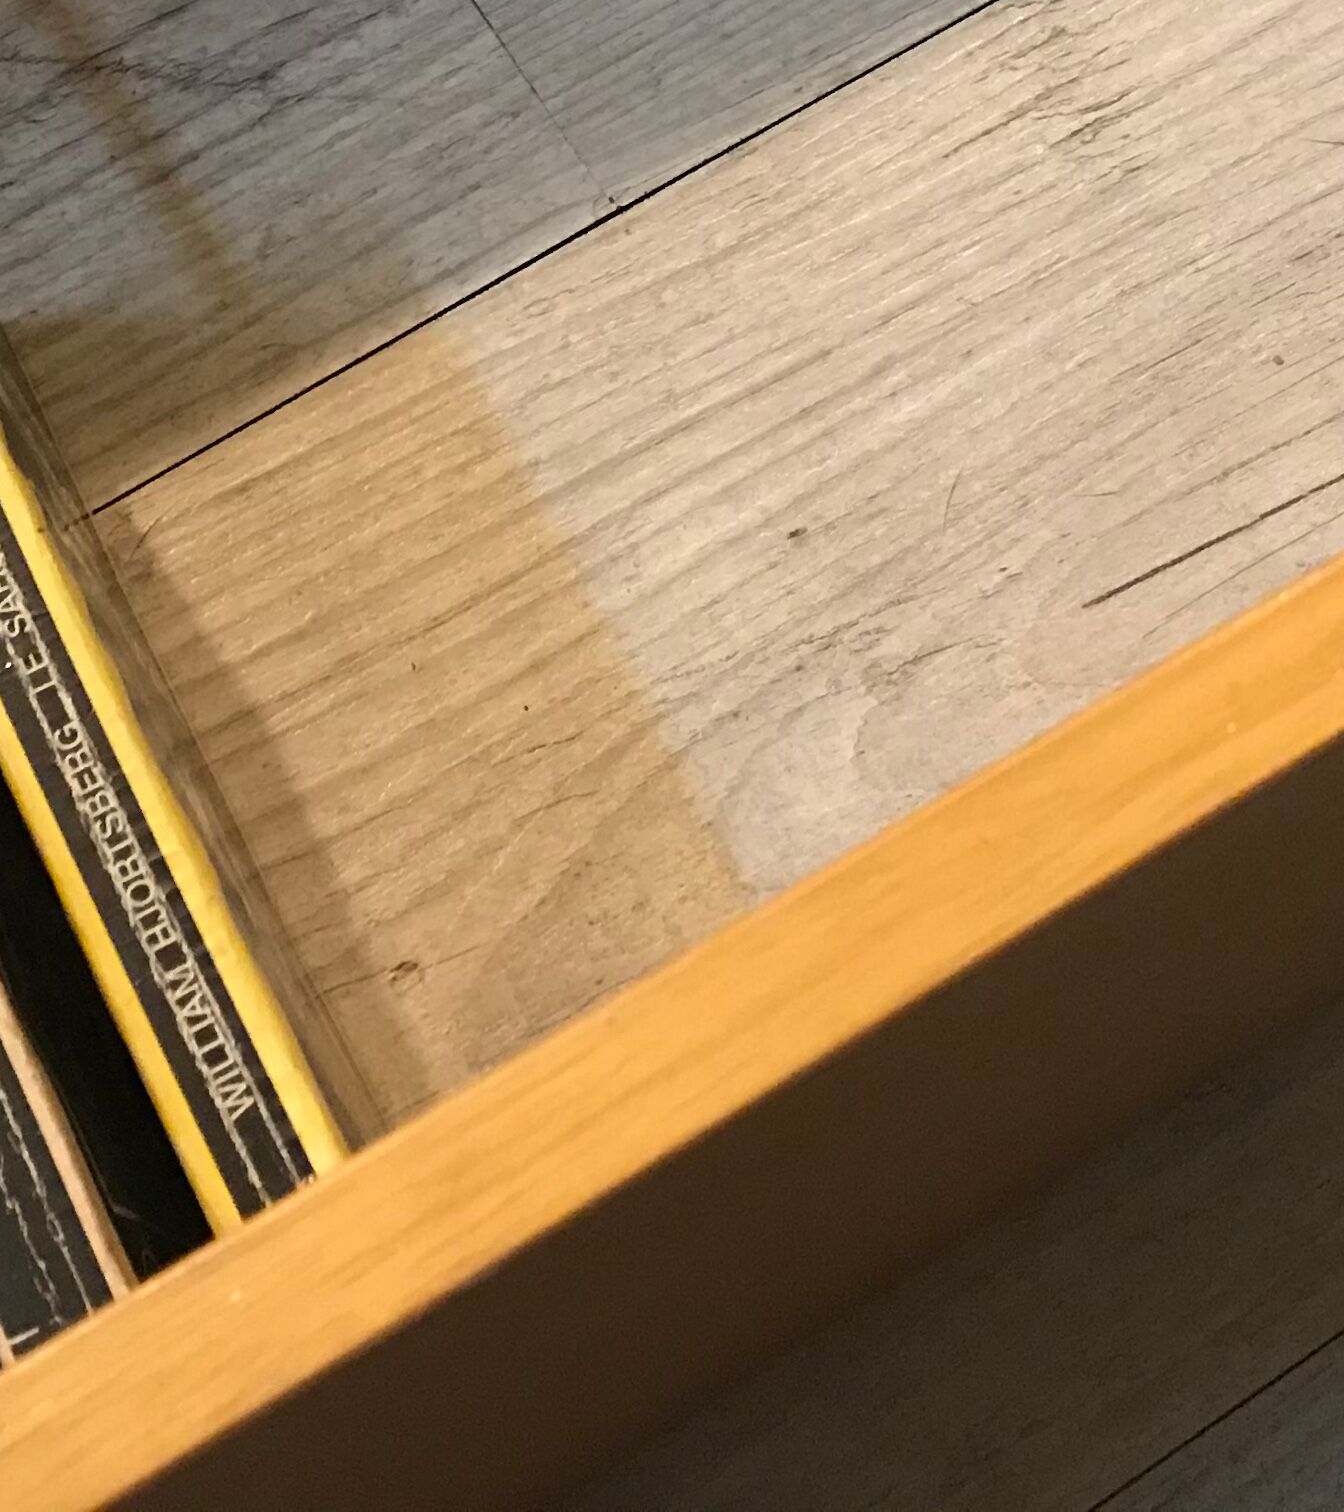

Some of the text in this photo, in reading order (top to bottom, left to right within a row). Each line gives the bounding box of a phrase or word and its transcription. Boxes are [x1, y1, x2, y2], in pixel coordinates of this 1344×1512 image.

[16, 646, 58, 695] LE
[49, 719, 179, 953] HJORTSBERG
[159, 960, 258, 1123] WILLIAM
